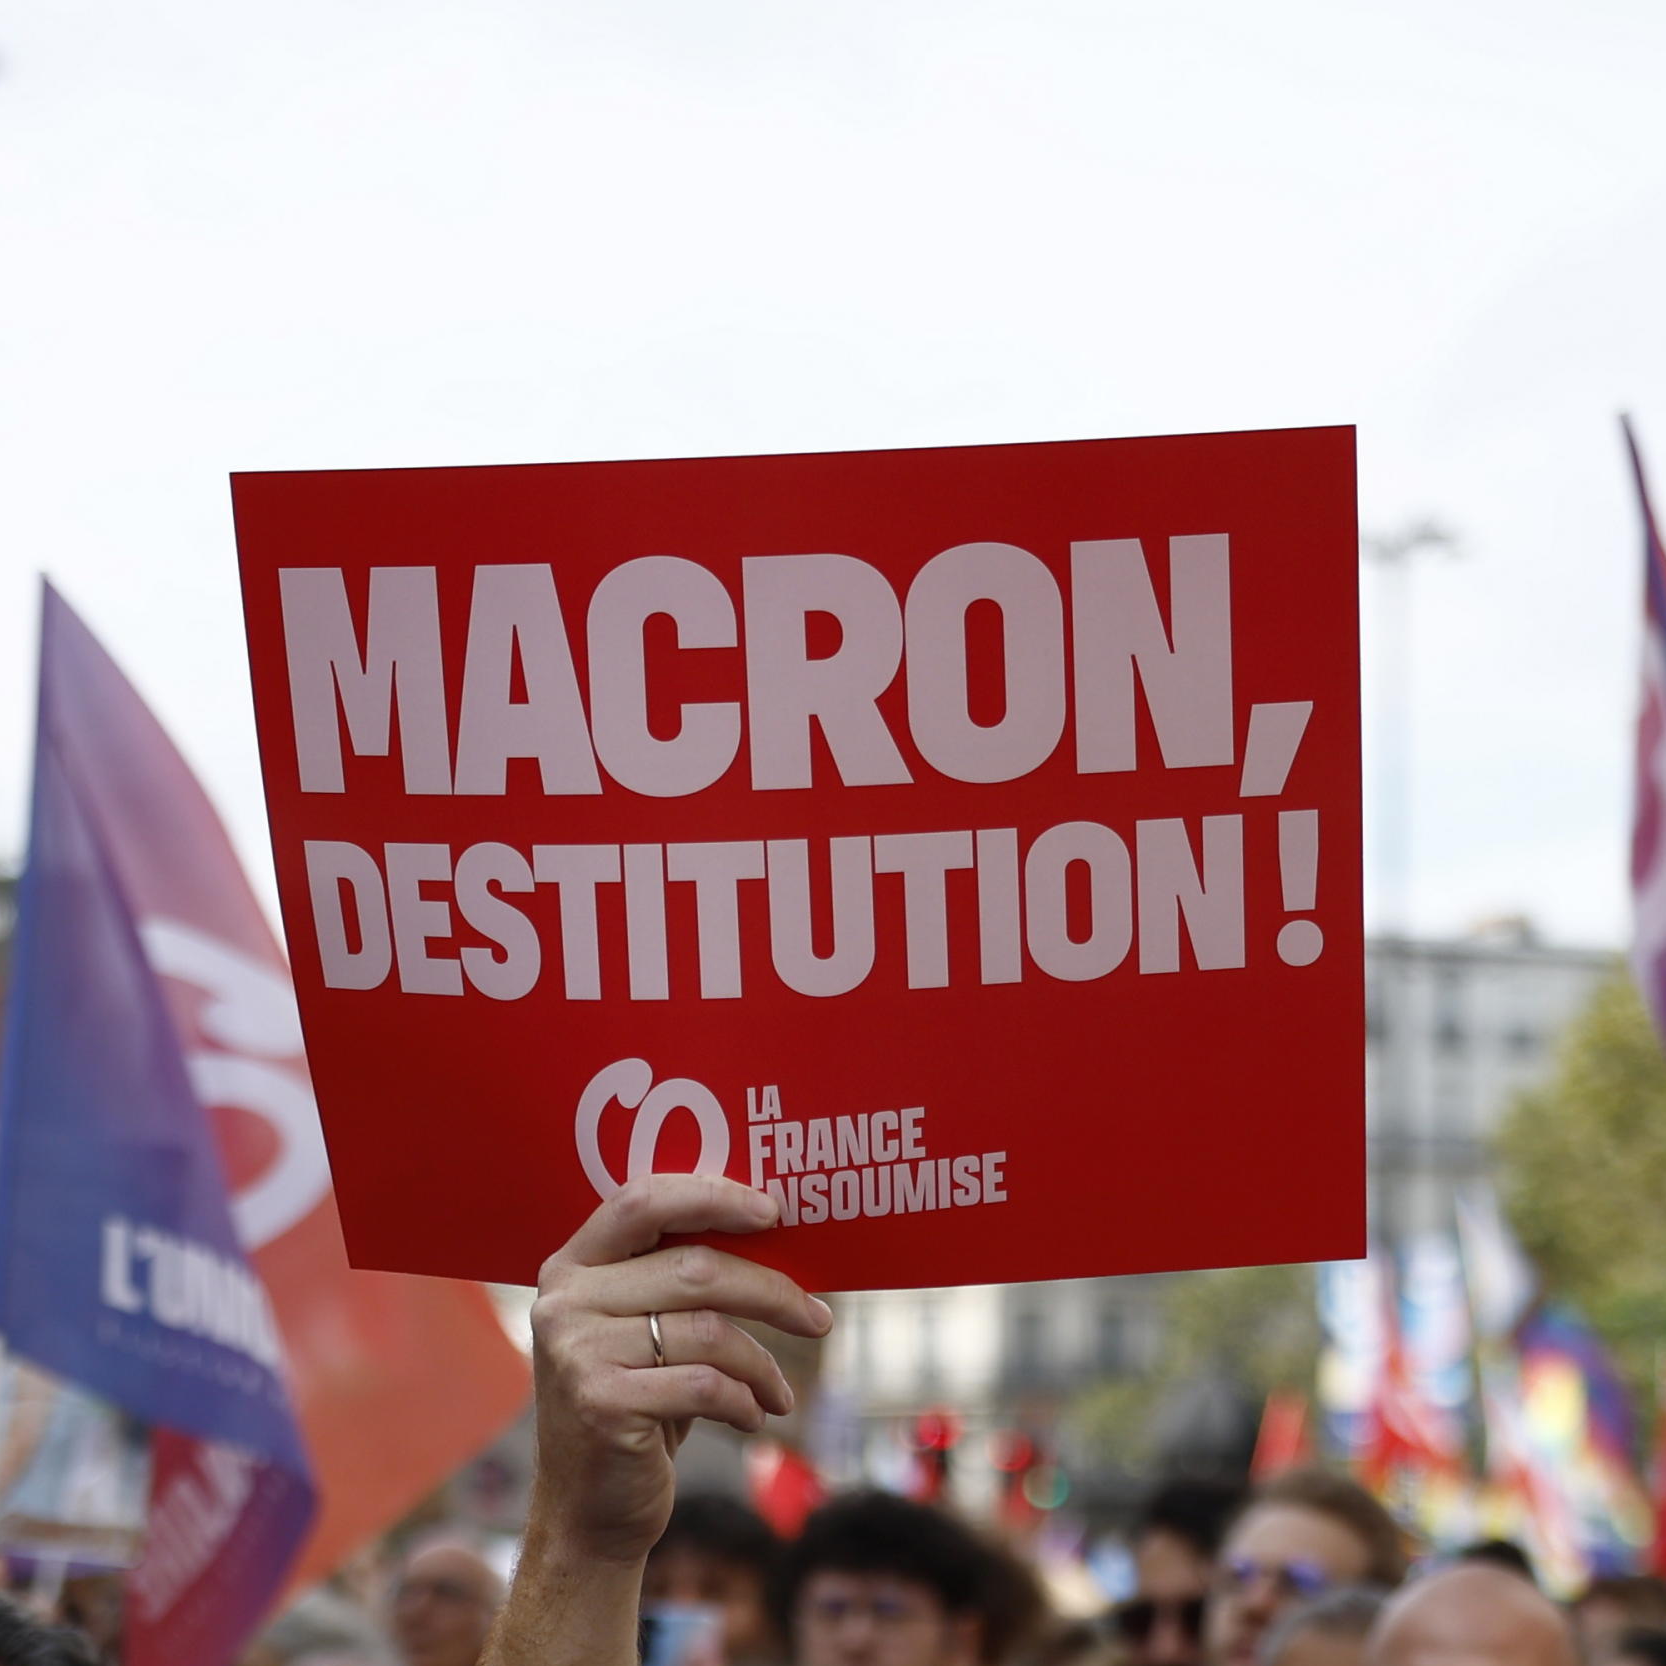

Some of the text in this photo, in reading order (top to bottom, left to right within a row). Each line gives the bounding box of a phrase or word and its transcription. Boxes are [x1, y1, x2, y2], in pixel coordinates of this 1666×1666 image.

[278, 532, 1314, 798] MACRON,
[746, 1085, 782, 1123] LA
[748, 1106, 926, 1190] FRANCE
[765, 1150, 1008, 1230] NSOUMISE
